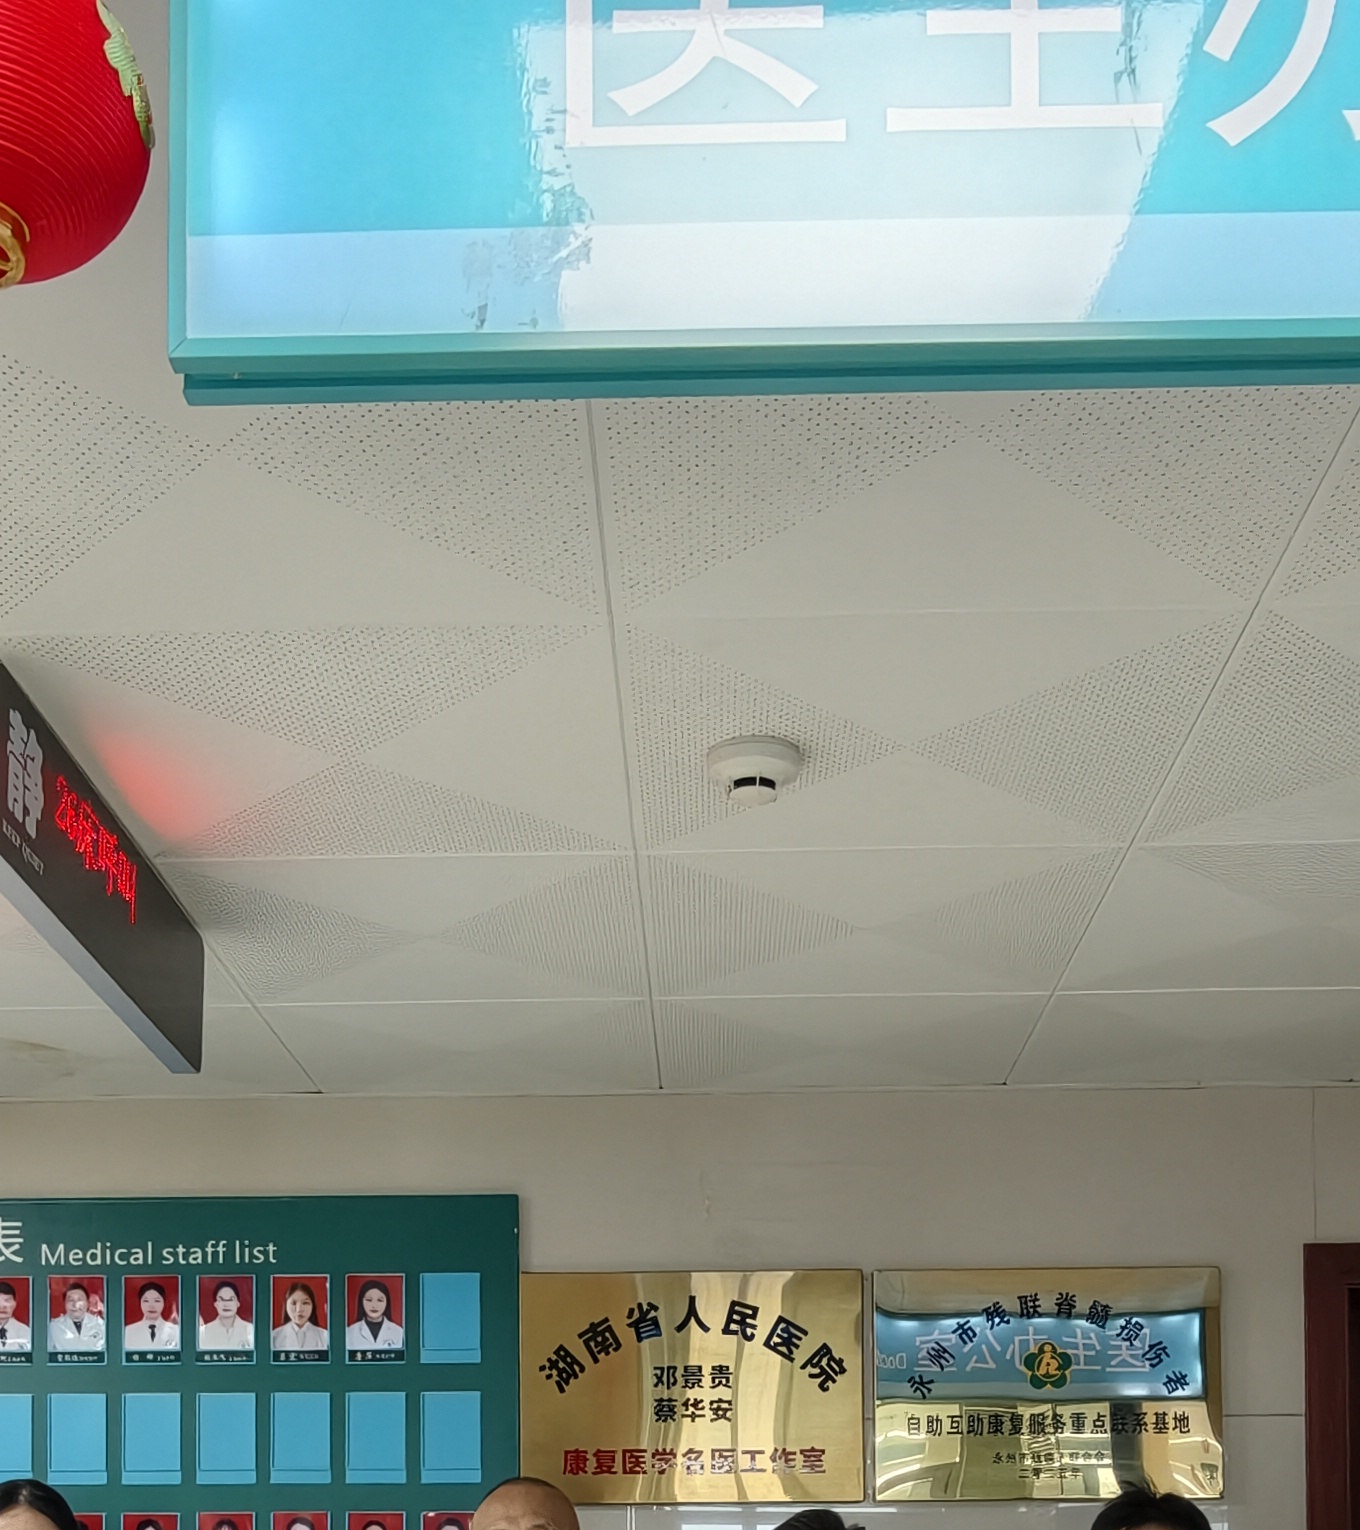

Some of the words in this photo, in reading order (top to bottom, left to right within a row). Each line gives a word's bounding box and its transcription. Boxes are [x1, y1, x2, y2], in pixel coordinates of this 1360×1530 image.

[41, 1240, 153, 1267] Medical
[161, 1240, 228, 1265] staff
[235, 1240, 278, 1264] list
[539, 1295, 847, 1394] 湖南省人民医院
[907, 1292, 1191, 1399] 永州市残联脊髓损伤者
[652, 1364, 734, 1390] 邓景贵
[653, 1397, 733, 1423] 蔡华安
[562, 1446, 826, 1476] 康复医学名医工作室
